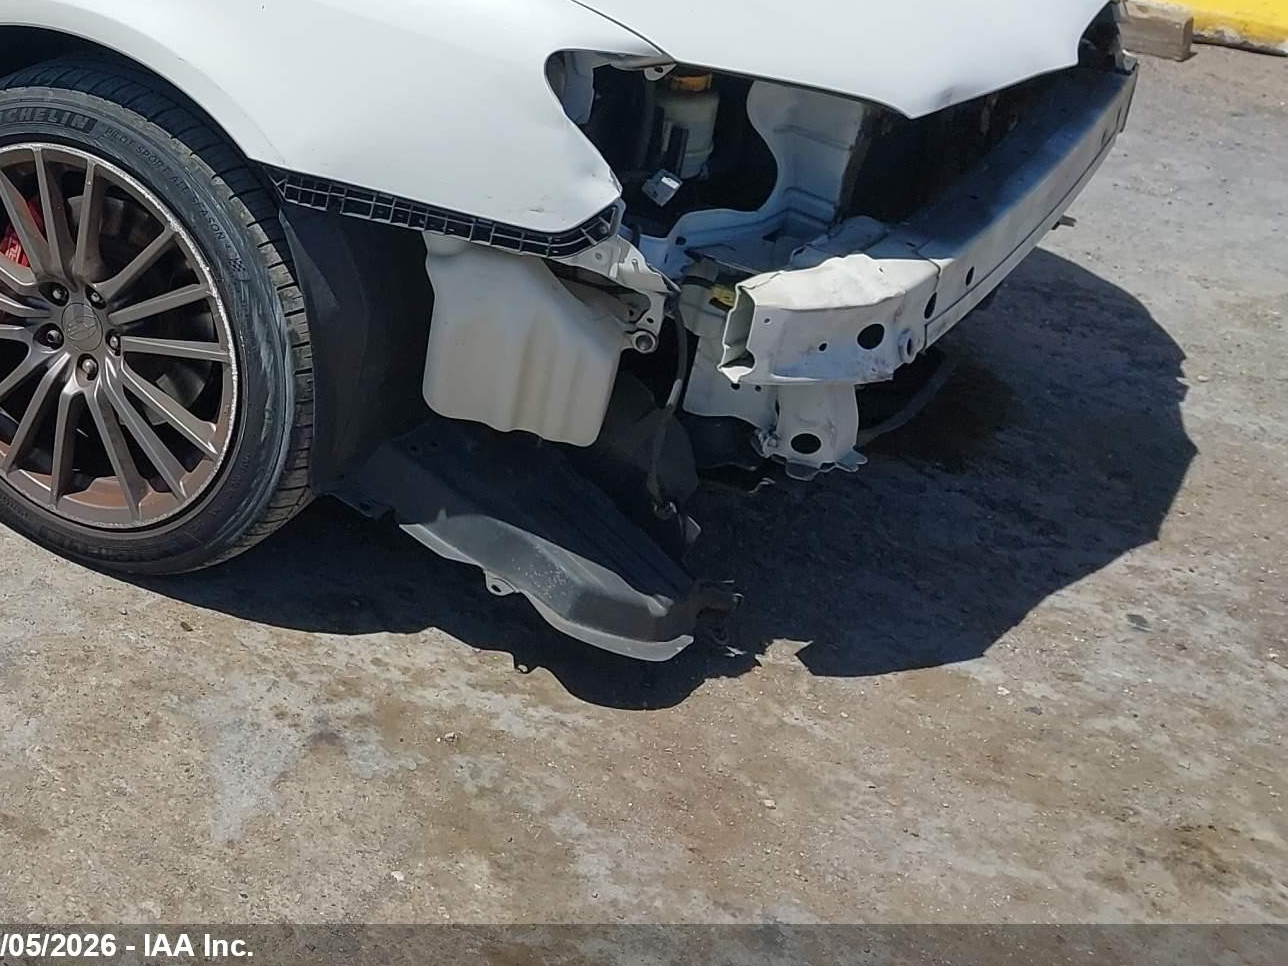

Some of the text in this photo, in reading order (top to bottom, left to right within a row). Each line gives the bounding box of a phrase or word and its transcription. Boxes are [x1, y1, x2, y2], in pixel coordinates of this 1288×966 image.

[104, 127, 133, 147] PILOT
[136, 145, 170, 174] SPORT
[191, 196, 226, 241] SEASON
